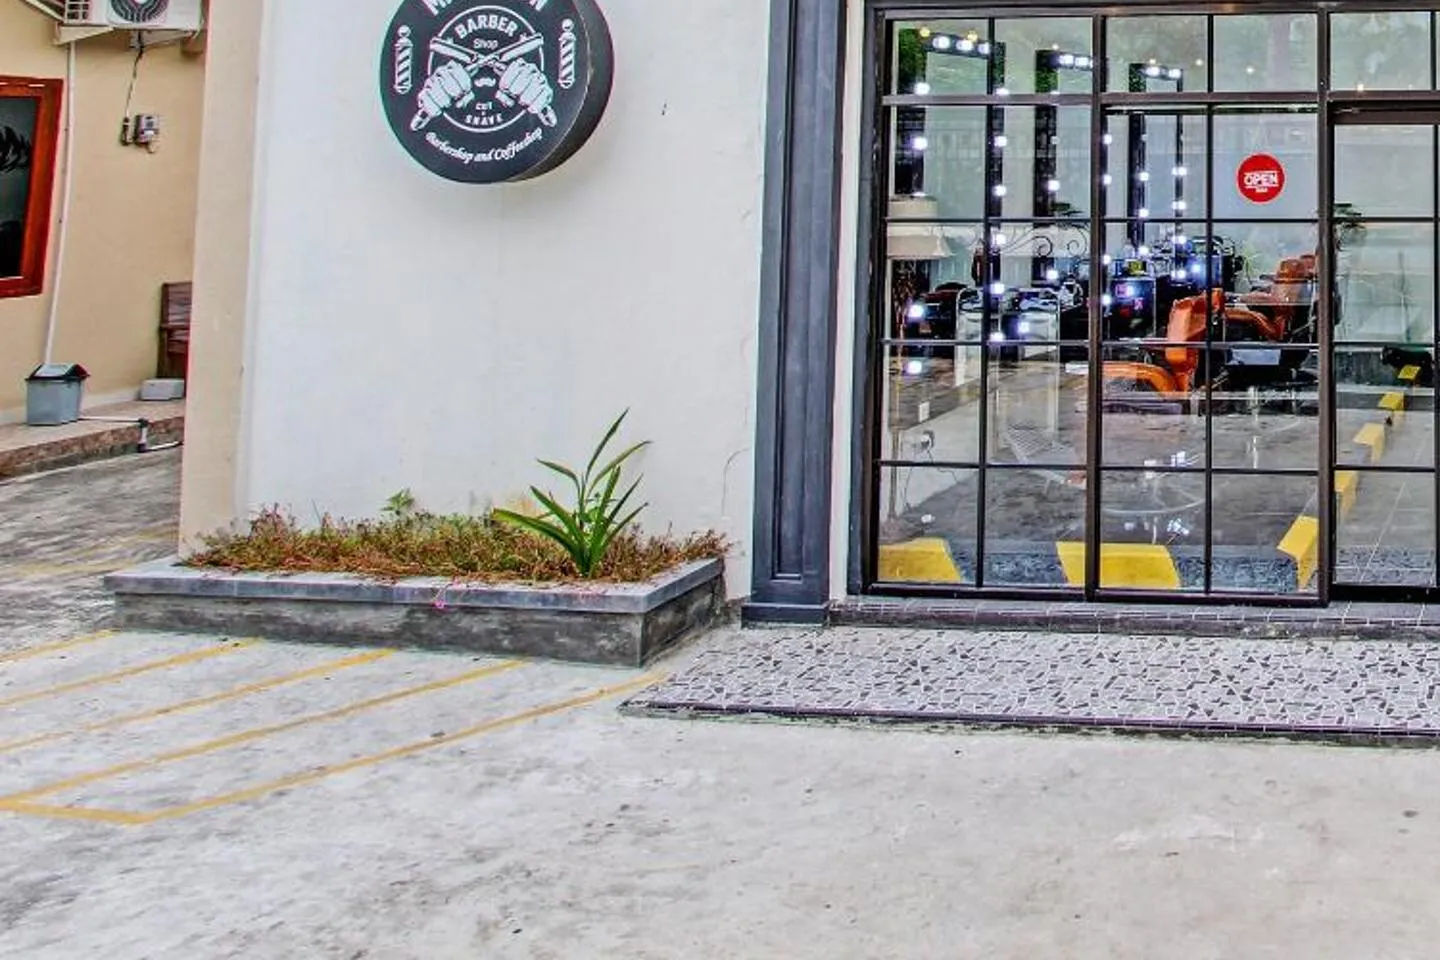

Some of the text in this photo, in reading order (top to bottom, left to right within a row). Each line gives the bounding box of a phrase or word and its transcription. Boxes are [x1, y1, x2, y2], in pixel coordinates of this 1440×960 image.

[454, 14, 518, 39] BARBER
[473, 38, 499, 50] Shop
[465, 113, 503, 126] SHAVE
[474, 148, 494, 161] and
[1244, 174, 1278, 186] OPEN
